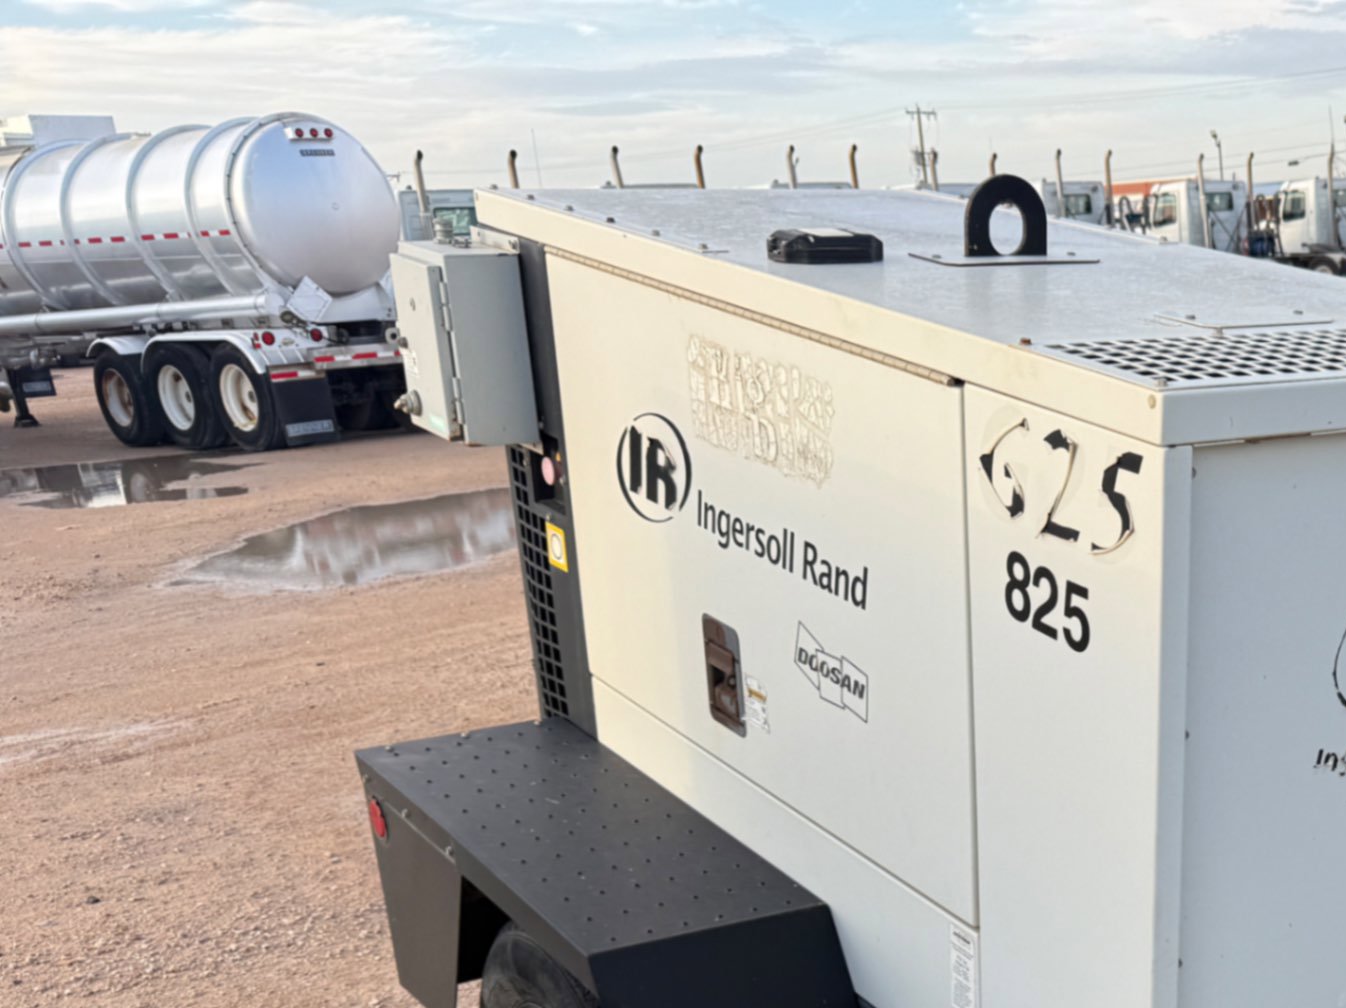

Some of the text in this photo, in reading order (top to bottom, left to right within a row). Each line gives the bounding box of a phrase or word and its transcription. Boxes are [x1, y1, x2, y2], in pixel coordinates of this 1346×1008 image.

[696, 489, 869, 611] Ingersoll Rand
[1004, 551, 1091, 652] 825
[797, 646, 866, 700] DOOSAN
